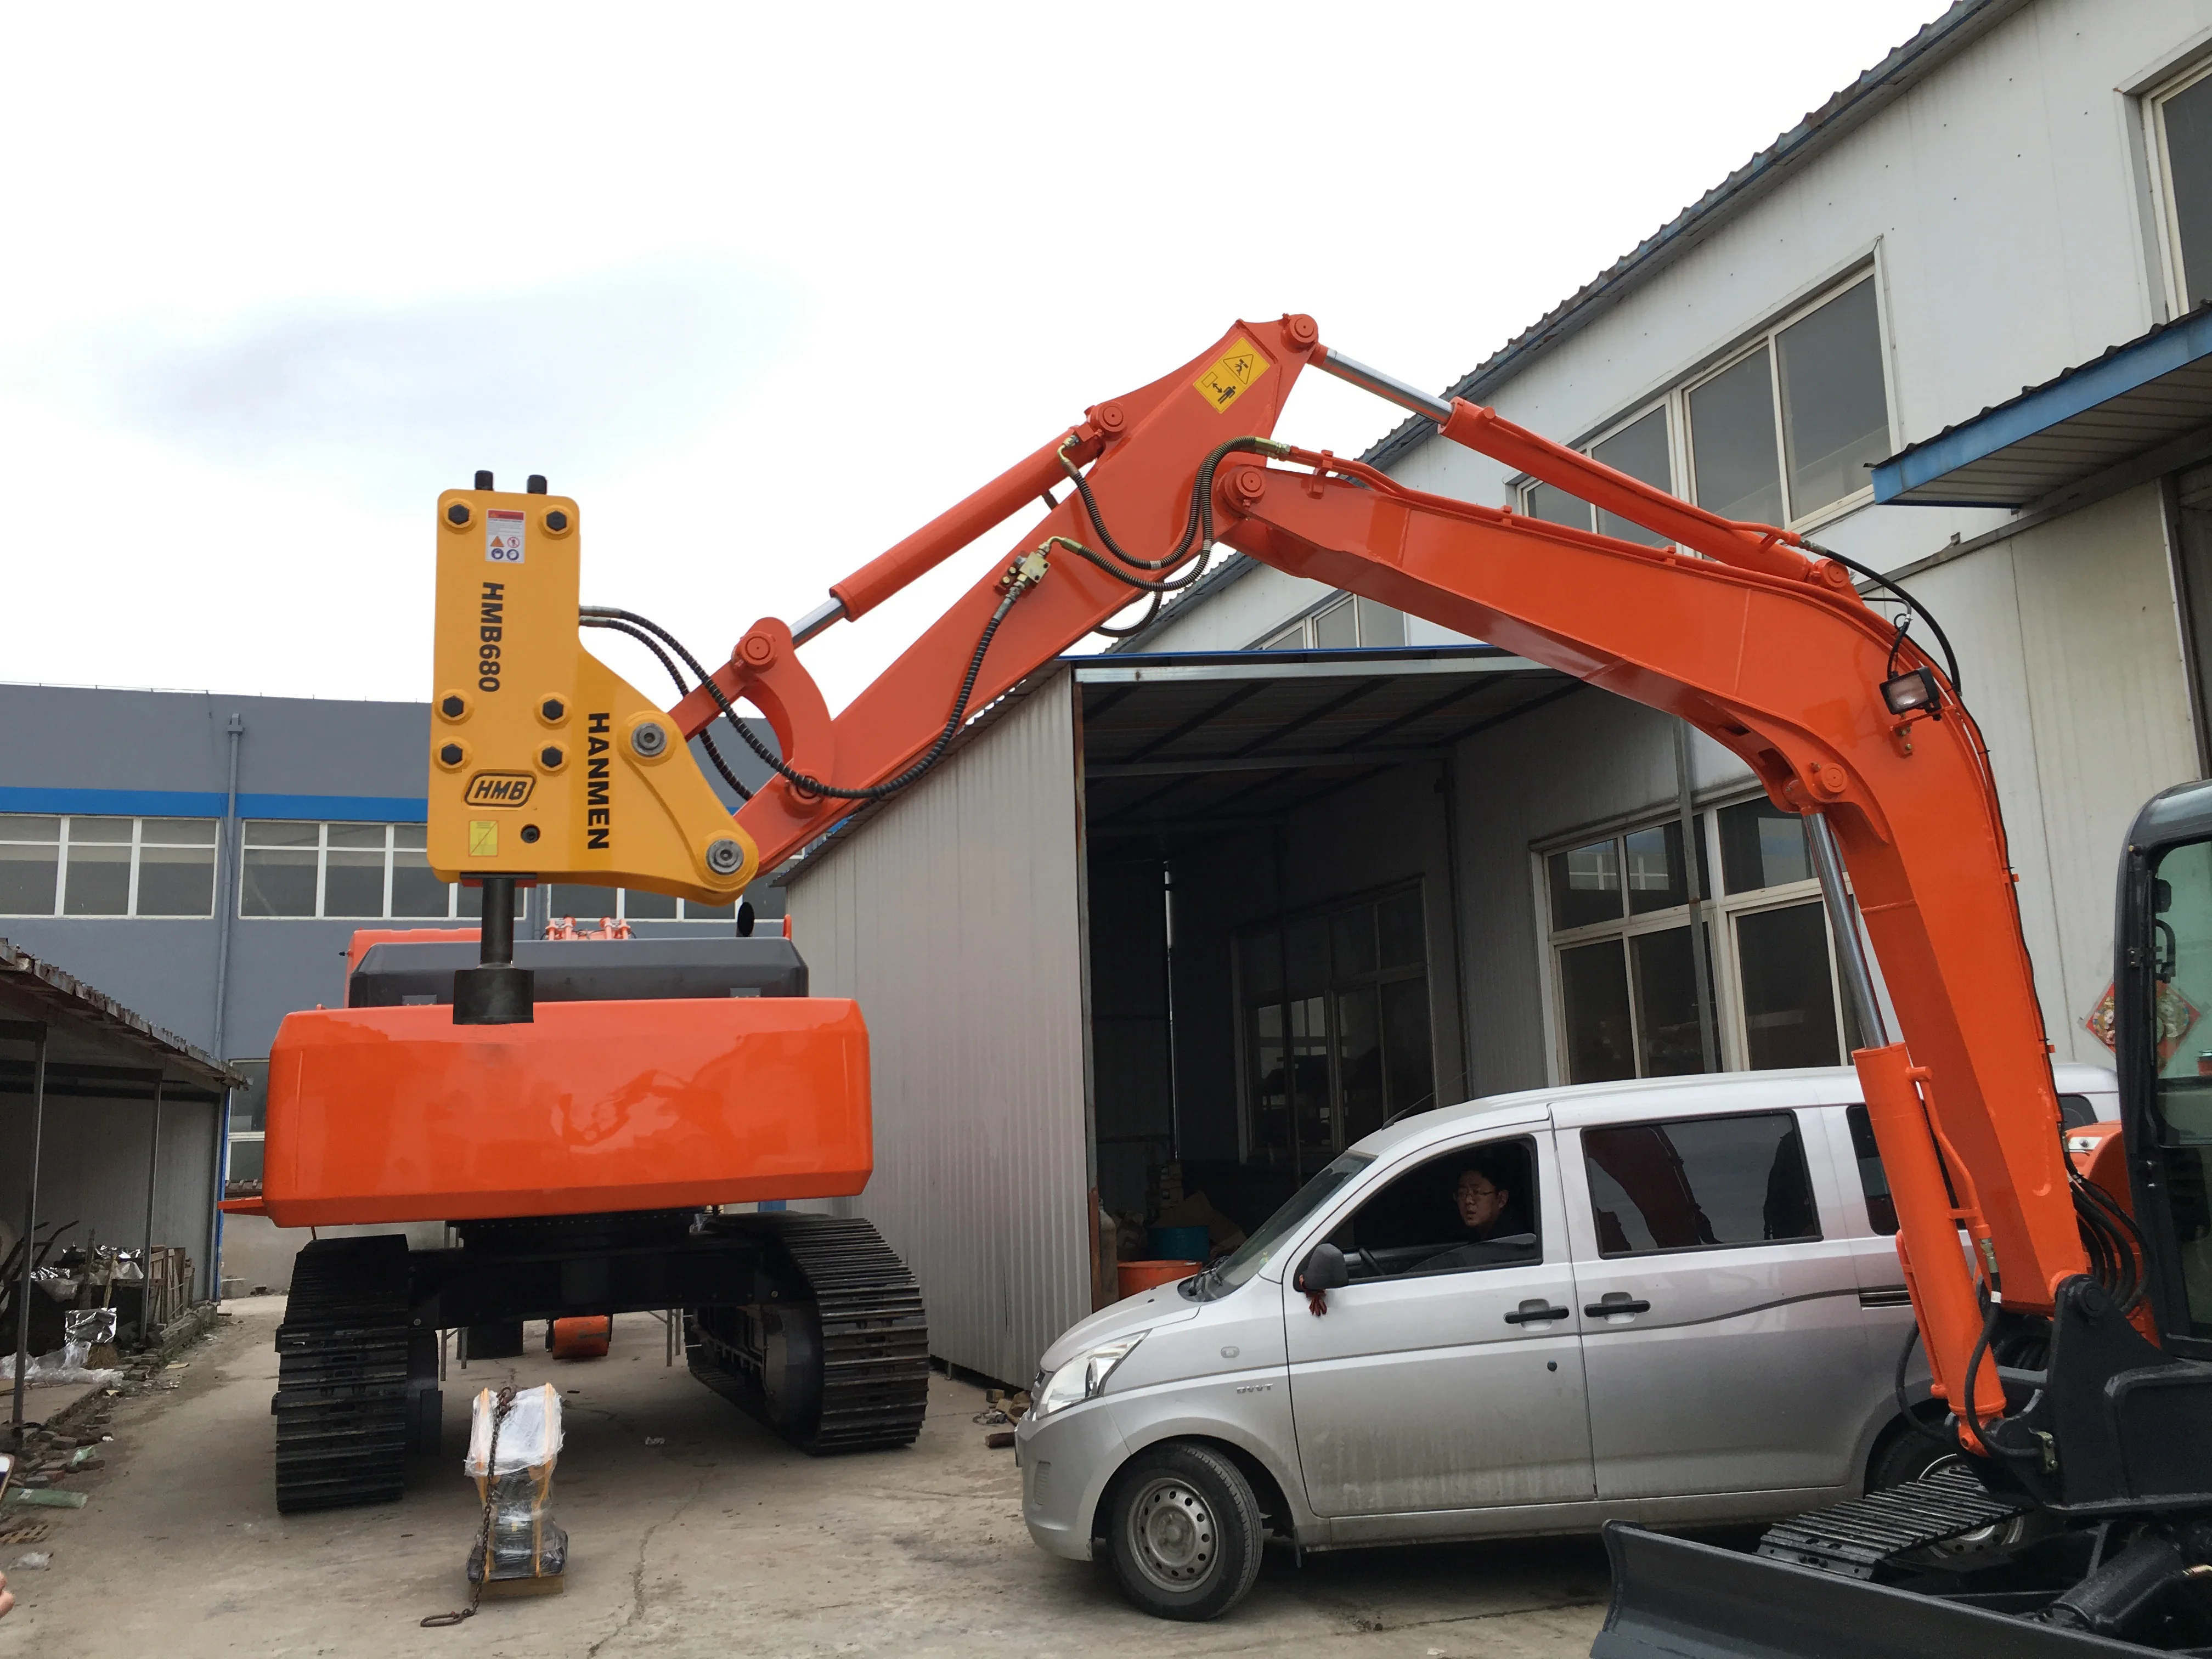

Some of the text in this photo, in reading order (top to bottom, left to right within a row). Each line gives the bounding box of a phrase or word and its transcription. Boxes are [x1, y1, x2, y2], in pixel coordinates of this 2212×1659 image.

[478, 582, 505, 692] HMB680
[473, 780, 527, 800] HMB
[588, 713, 610, 849] HANMEN
